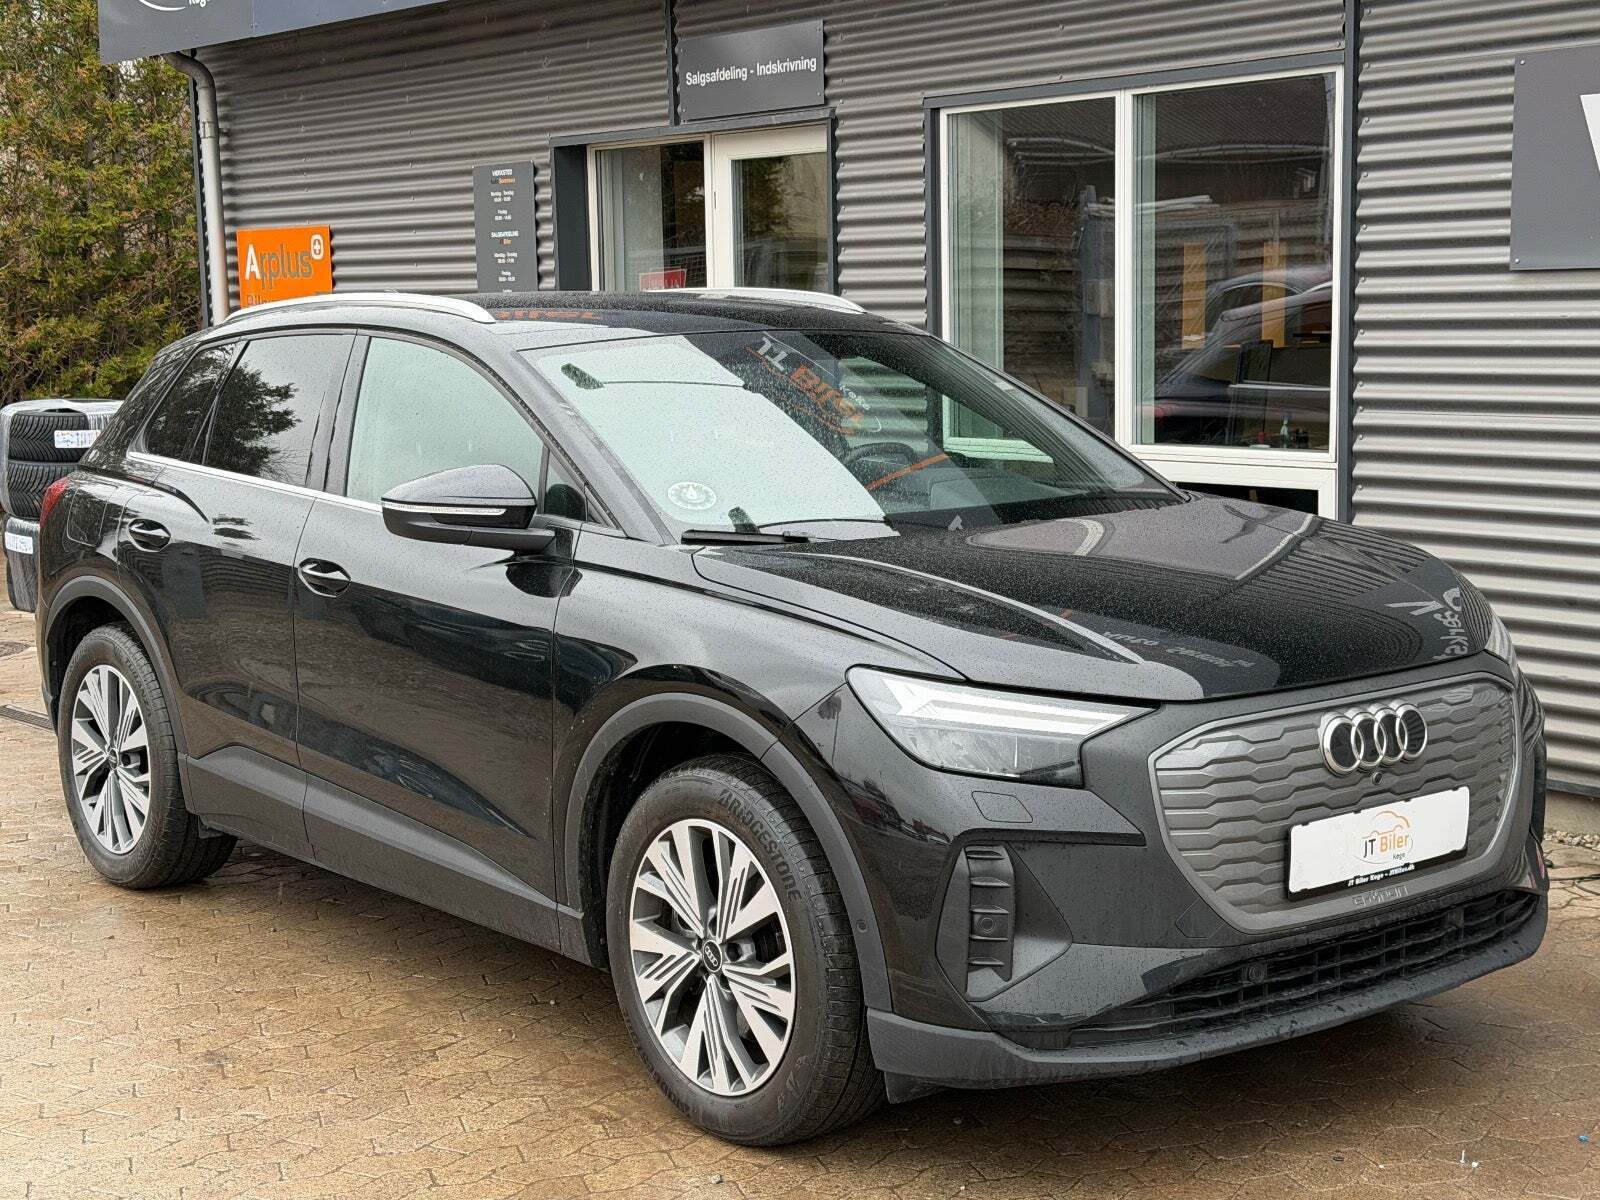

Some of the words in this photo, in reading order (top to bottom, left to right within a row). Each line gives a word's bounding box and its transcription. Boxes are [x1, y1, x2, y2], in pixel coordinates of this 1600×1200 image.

[685, 66, 748, 87] Salgsafdeling
[756, 56, 817, 76] Indskrivning
[1364, 838, 1376, 858] JT
[1381, 834, 1409, 852] Biler
